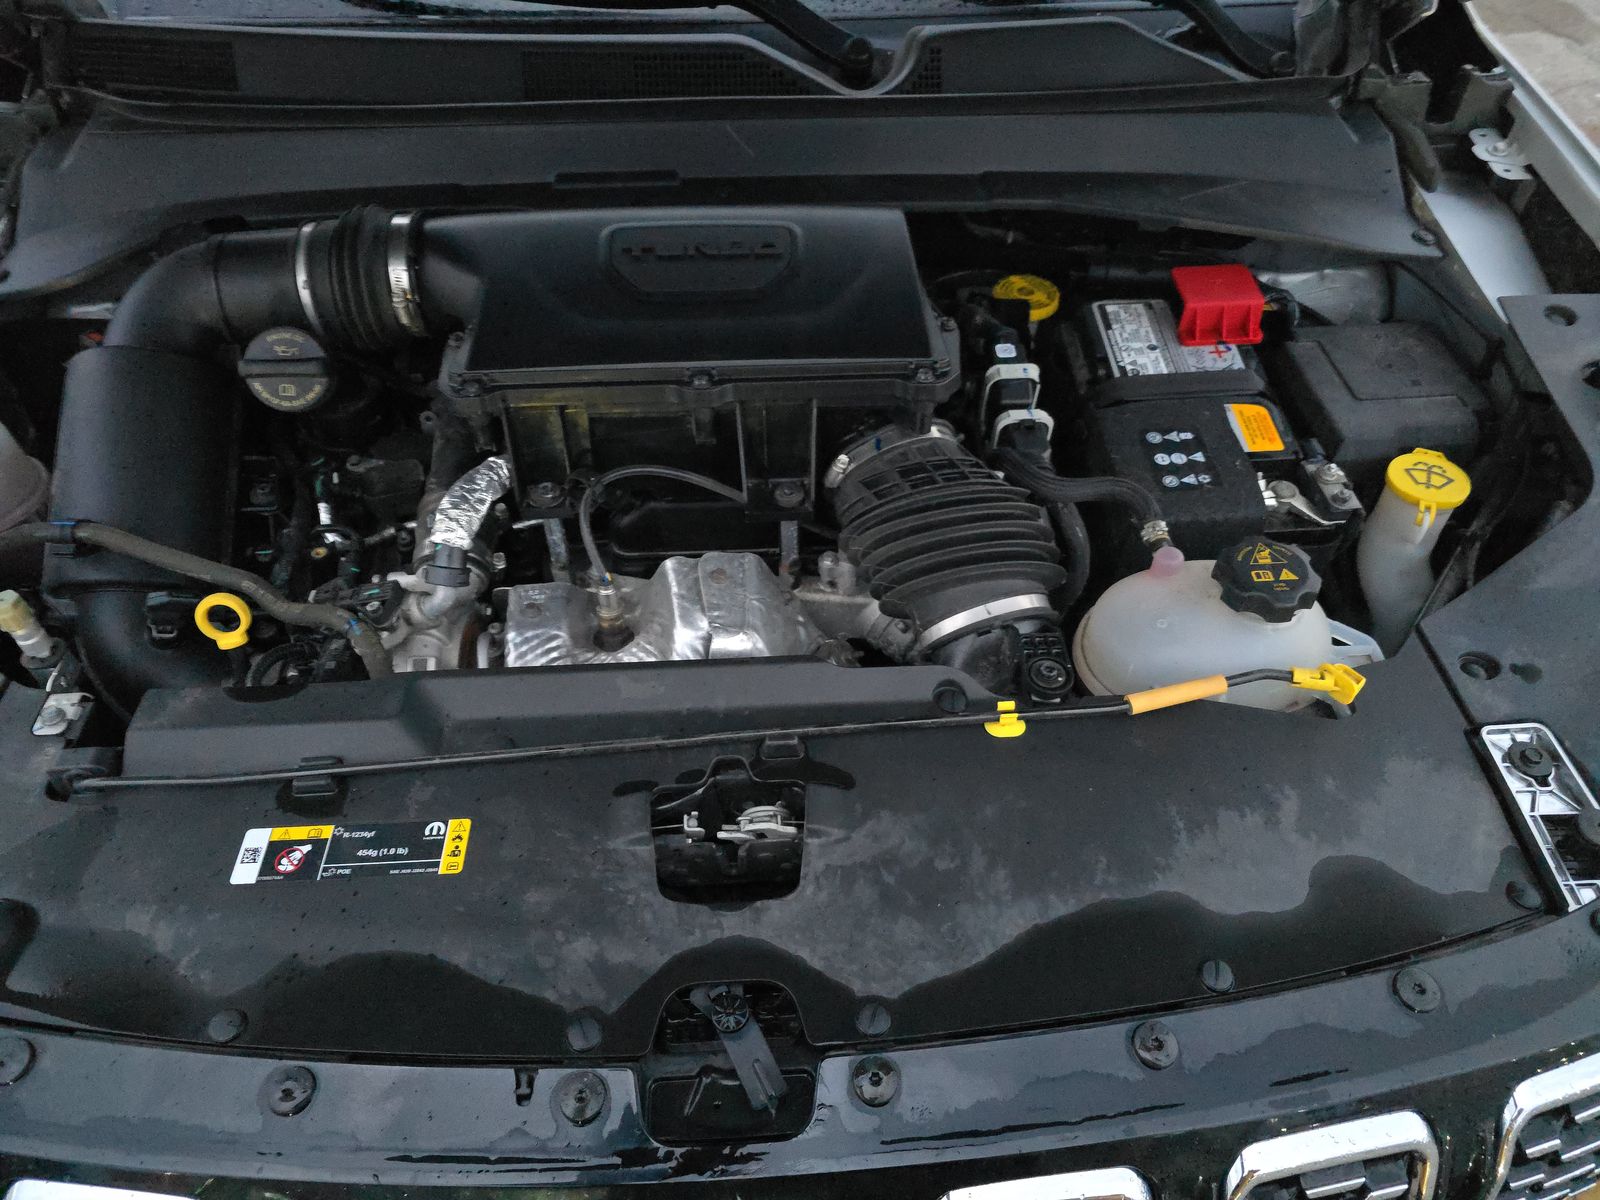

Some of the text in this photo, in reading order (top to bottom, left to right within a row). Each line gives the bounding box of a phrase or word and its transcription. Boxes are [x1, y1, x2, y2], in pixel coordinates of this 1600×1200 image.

[357, 847, 409, 857] 454g (1.0 lb)
